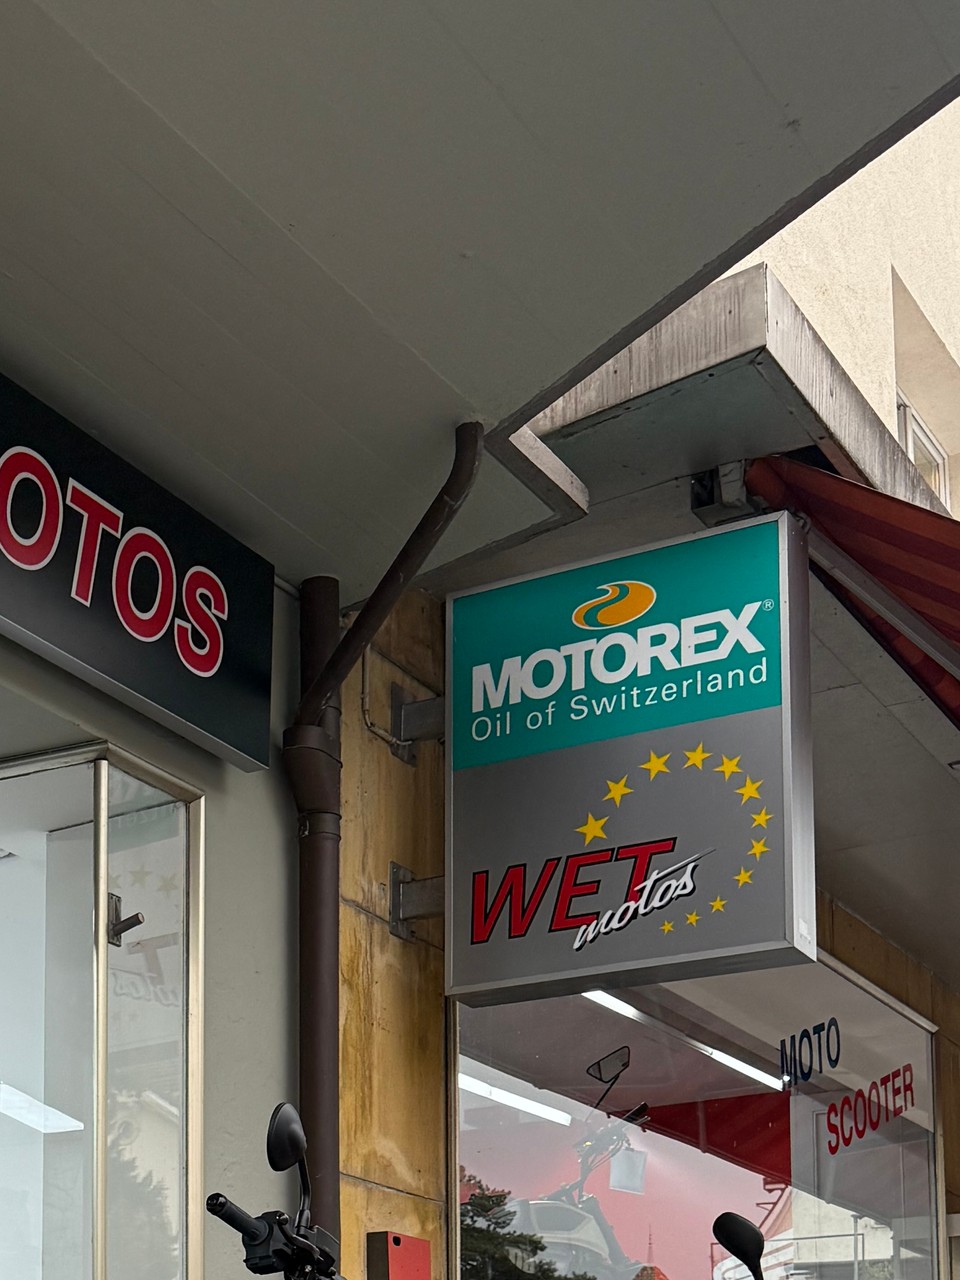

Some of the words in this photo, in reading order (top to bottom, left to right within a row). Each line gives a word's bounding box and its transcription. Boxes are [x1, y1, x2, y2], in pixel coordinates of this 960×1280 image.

[471, 708, 511, 741] Oil
[526, 693, 556, 729] of
[570, 657, 768, 721] Switzerland
[471, 837, 677, 945] WET
[573, 850, 714, 951] motos
[780, 1017, 840, 1091] MOTO
[826, 1063, 915, 1155] SCOOTER
